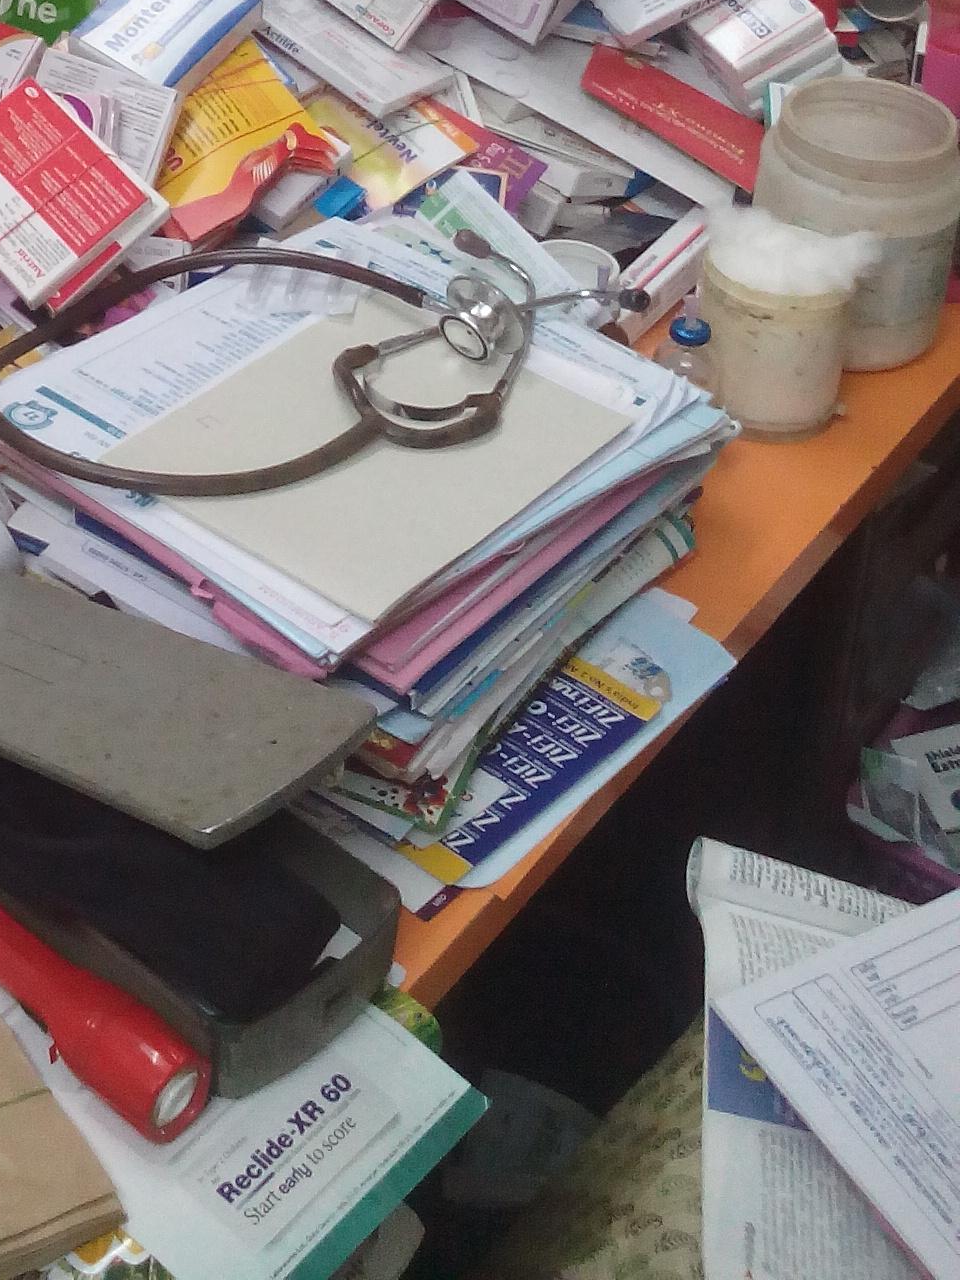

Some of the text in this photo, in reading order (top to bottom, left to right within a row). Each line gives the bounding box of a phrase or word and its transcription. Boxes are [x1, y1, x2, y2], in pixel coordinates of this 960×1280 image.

[216, 1097, 326, 1205] Reclide-XR
[320, 1072, 353, 1105] 60
[243, 1191, 282, 1227] Start
[277, 1160, 313, 1197] early
[306, 1145, 325, 1167] to
[321, 1113, 359, 1151] score
